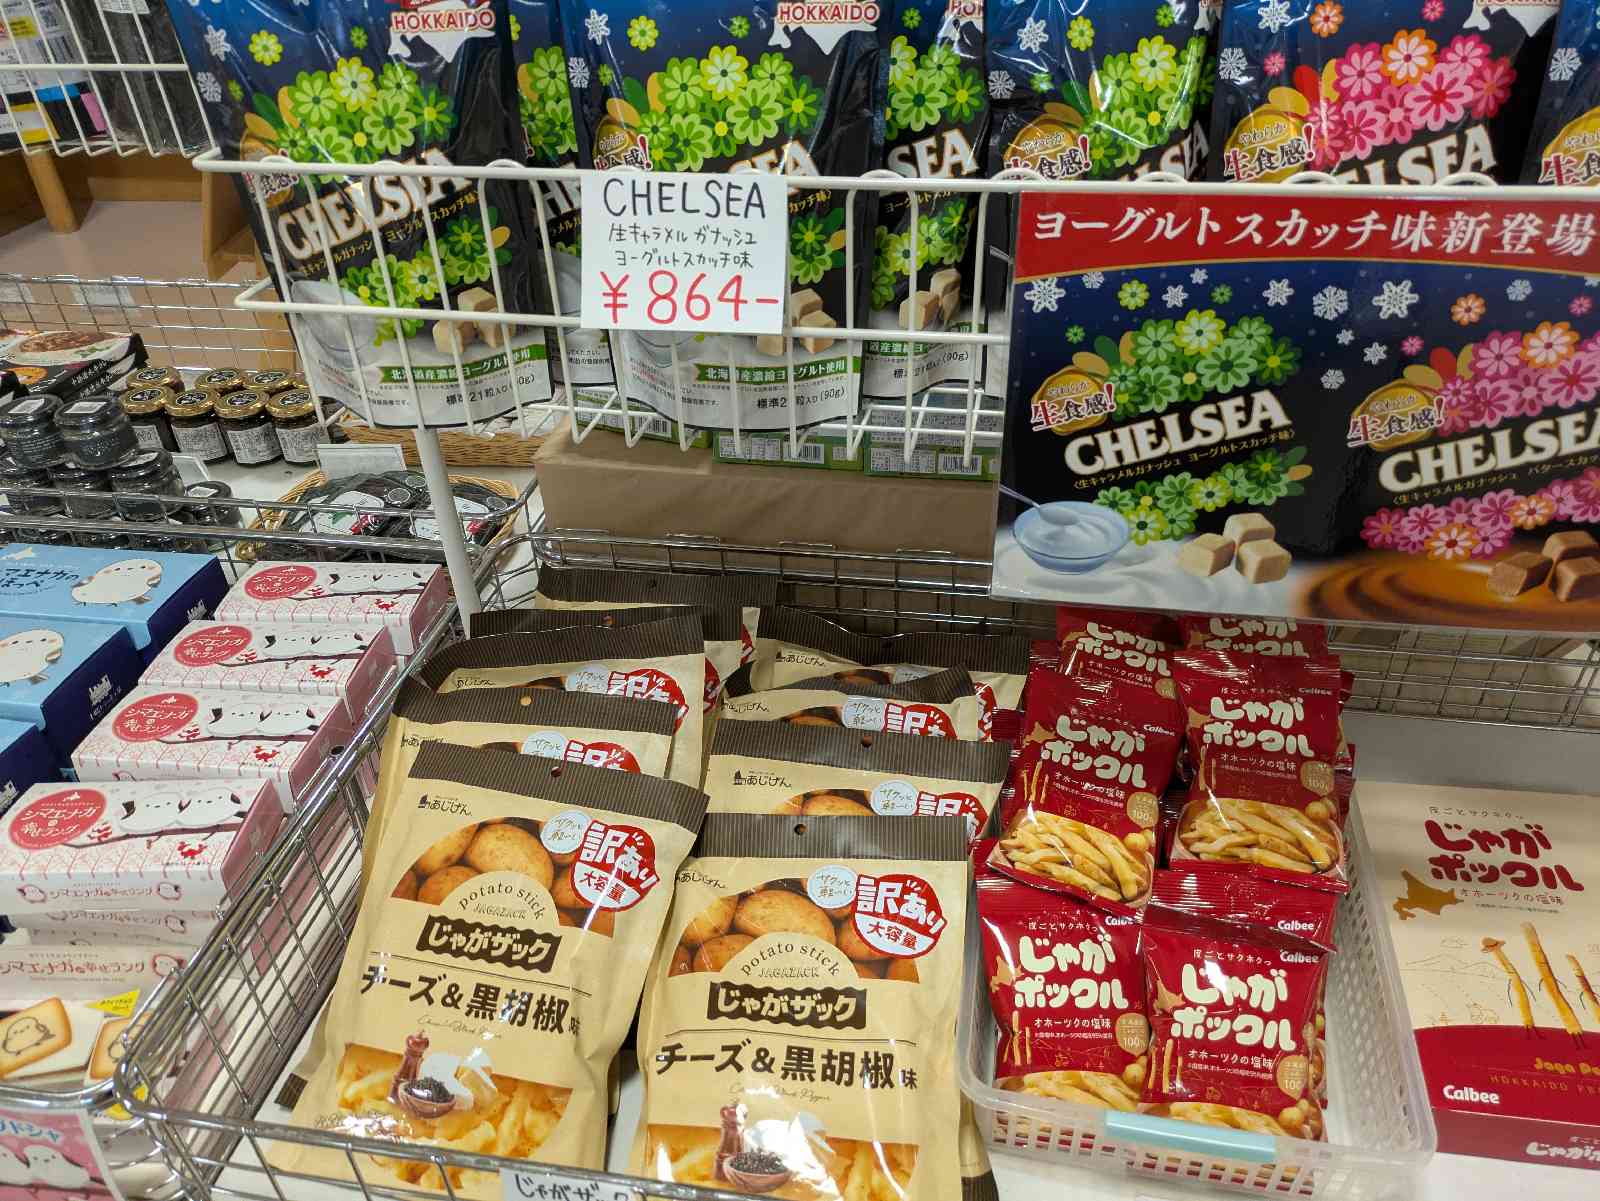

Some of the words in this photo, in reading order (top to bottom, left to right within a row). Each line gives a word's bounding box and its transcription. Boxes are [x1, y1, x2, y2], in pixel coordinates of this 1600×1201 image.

[392, 9, 496, 31] HOKKAIDO
[778, 4, 879, 22] HOKKAIDO
[603, 178, 766, 219] CHELSEA
[1033, 206, 1596, 255] ヨーグルトスカッチ味新登場
[616, 249, 753, 268] ヨーグルトスカッチ味
[1064, 388, 1292, 476] CHELSEA
[1075, 636, 1172, 677] ポックル
[1086, 621, 1167, 655] じゃが
[1210, 696, 1305, 730] じゃが
[1055, 714, 1146, 758] じゃが
[1202, 720, 1315, 759] ポックル
[1040, 740, 1148, 789] ポックル
[579, 822, 658, 890] 訳あり
[1424, 820, 1553, 860] じゃが
[1427, 853, 1585, 892] ポックル
[458, 880, 514, 911] potato
[516, 888, 545, 920] stick
[857, 876, 944, 935] 訳あり
[429, 922, 552, 964] じゃがザック
[867, 921, 918, 950] 大容量
[1277, 920, 1315, 931] Calbee
[741, 943, 795, 977] potato
[799, 944, 841, 977] stick
[1019, 935, 1116, 974] じゃが
[1279, 949, 1320, 964] Calbee
[716, 987, 857, 1022] じゃがザック
[1014, 974, 1130, 1009] ポックル
[1181, 963, 1289, 1013] じゃが
[1170, 1006, 1297, 1052] ポックル
[655, 1038, 920, 1090] チーズ&黒胡椒味
[1442, 1084, 1501, 1105] Calbee
